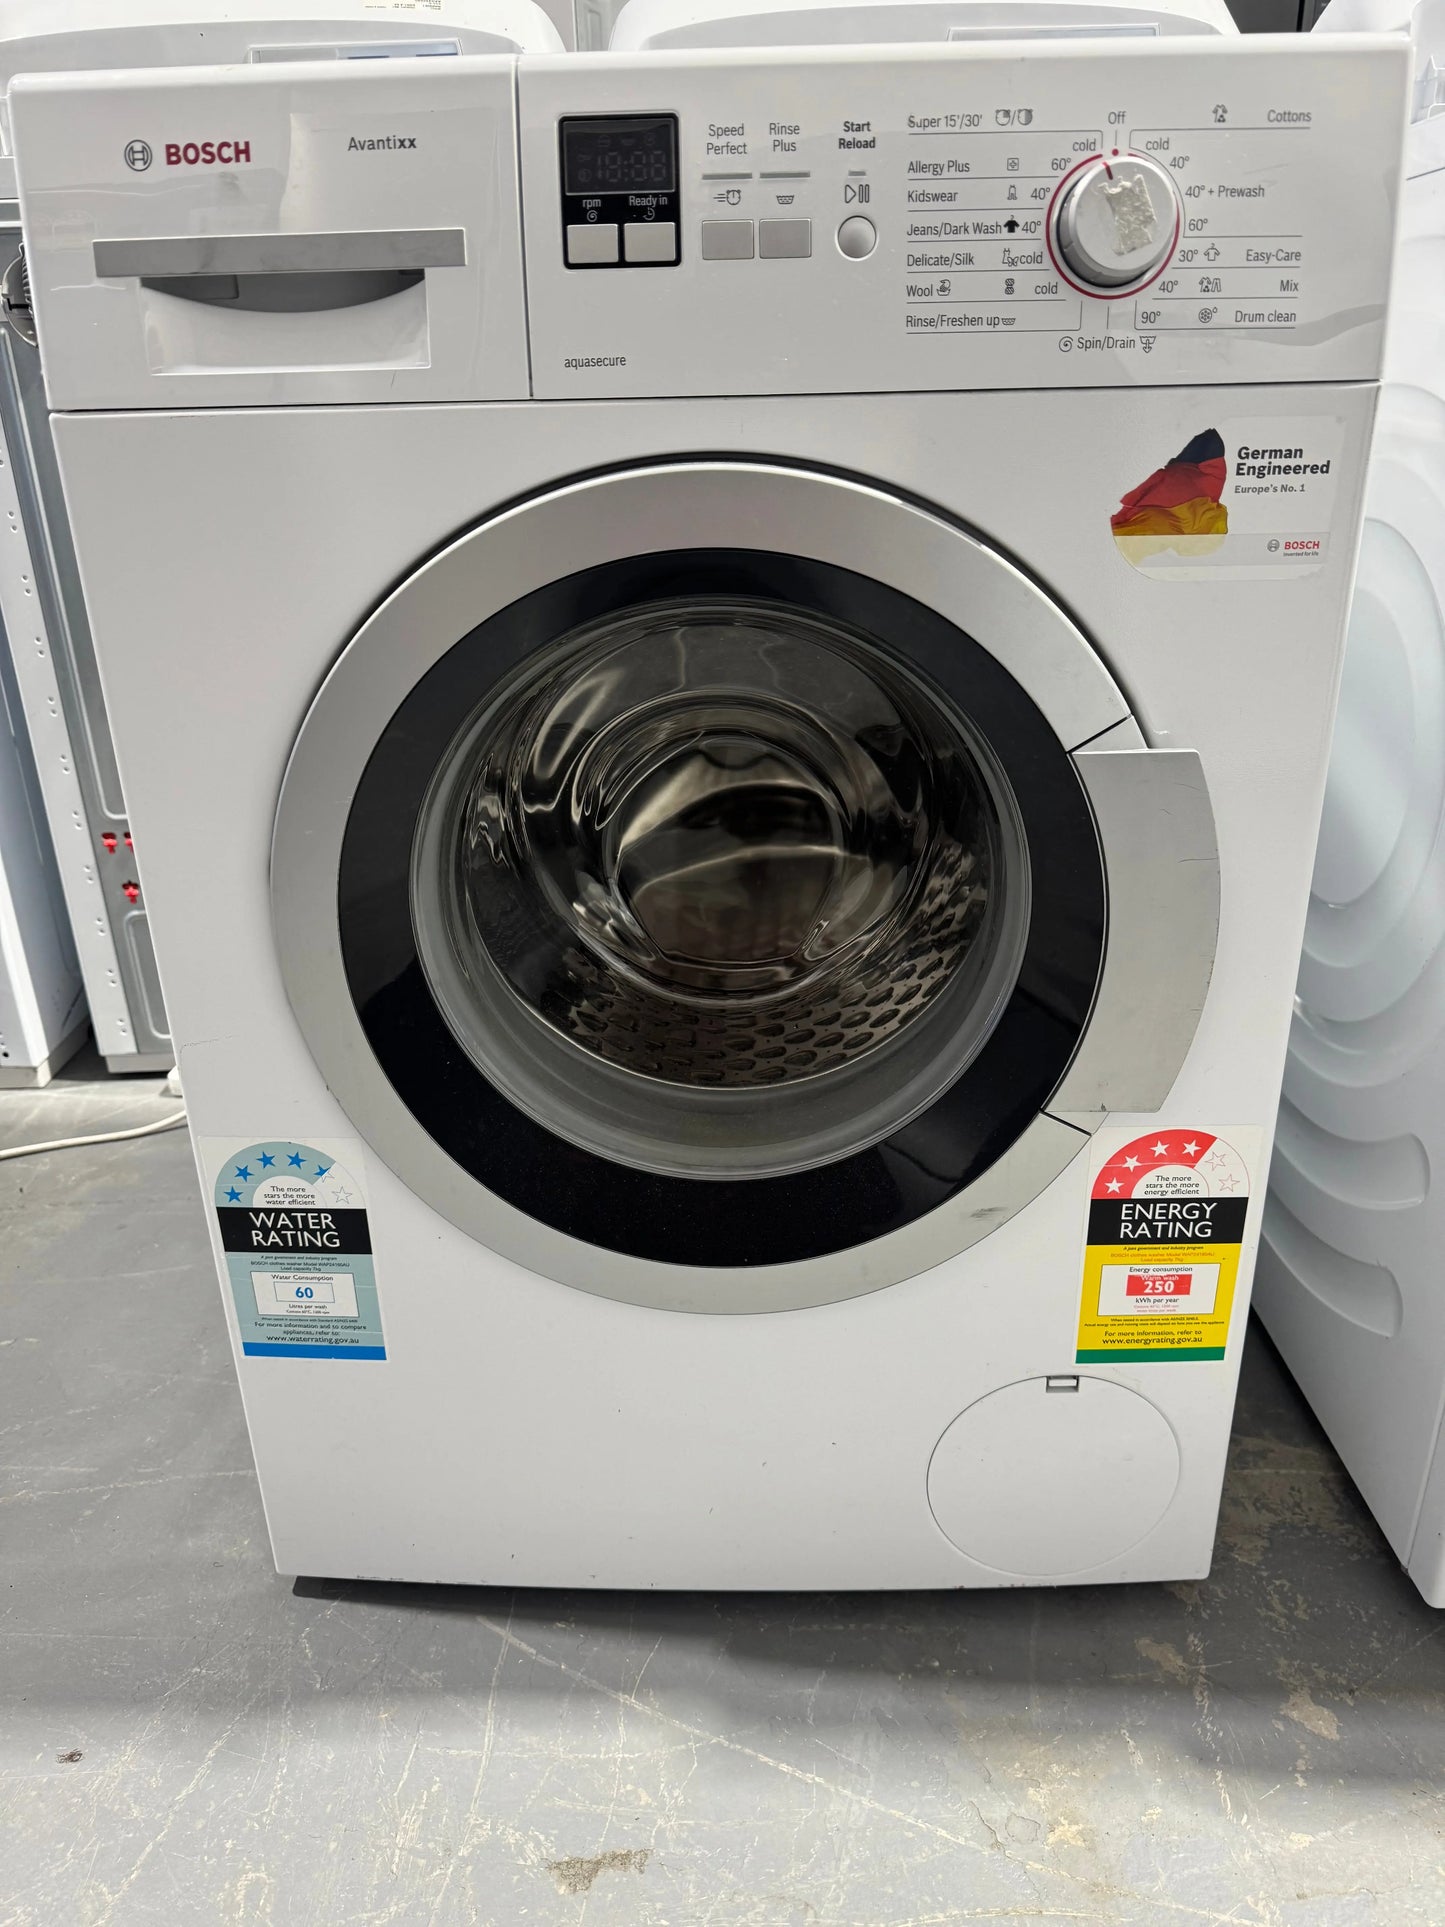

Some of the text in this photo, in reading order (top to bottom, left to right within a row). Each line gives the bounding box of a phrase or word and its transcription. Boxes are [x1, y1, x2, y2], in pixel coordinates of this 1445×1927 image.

[907, 113, 983, 131] Super 15'/30'
[1108, 111, 1126, 124] Off
[1267, 109, 1312, 123] Cottons
[708, 124, 744, 139] Speed
[769, 122, 800, 136] Rinse
[843, 121, 871, 133] Start
[348, 135, 417, 151] Avantixx
[706, 142, 747, 155] Perfect
[773, 139, 797, 152] Plus
[838, 137, 876, 150] Reload
[1072, 138, 1096, 152] cold
[1145, 137, 1170, 151] cold
[165, 141, 251, 165] BOSCH
[907, 157, 1072, 176] Allergy Plus 60°
[1169, 155, 1190, 169] 40°
[907, 187, 1051, 203] Kidswear 40°
[1185, 185, 1206, 198] 40°
[1217, 184, 1265, 198] Prewash
[582, 199, 602, 210] rpm
[629, 194, 668, 208] Ready in
[906, 220, 1042, 237] Jeans/Dark Wash 40°
[1188, 218, 1208, 231] 60°
[906, 252, 1044, 267] Delicate/Silk cold
[1178, 249, 1302, 264] 30° Easy-Care
[906, 282, 1058, 297] Wool cold
[1158, 279, 1299, 293] 40° Mix
[905, 313, 1000, 328] Rinse/Freshen up
[1140, 309, 1297, 324] 90° Drum clean
[1077, 336, 1136, 351] Spin/Drain
[564, 355, 627, 370] aquasecure
[1237, 446, 1303, 460] German
[1235, 460, 1330, 478] Engineered
[1234, 483, 1306, 495] Europe's No. 1
[1284, 541, 1320, 550] BOSCH
[1121, 1202, 1218, 1220] ENERGY
[249, 1212, 336, 1229] WATER
[1120, 1221, 1213, 1238] RATING
[251, 1230, 340, 1248] RATING
[295, 1287, 314, 1299] 60
[1143, 1281, 1175, 1293] 250
[266, 1335, 359, 1344] www.waterrating.gov.au
[1102, 1336, 1203, 1345] www.energyrating.gov.au
